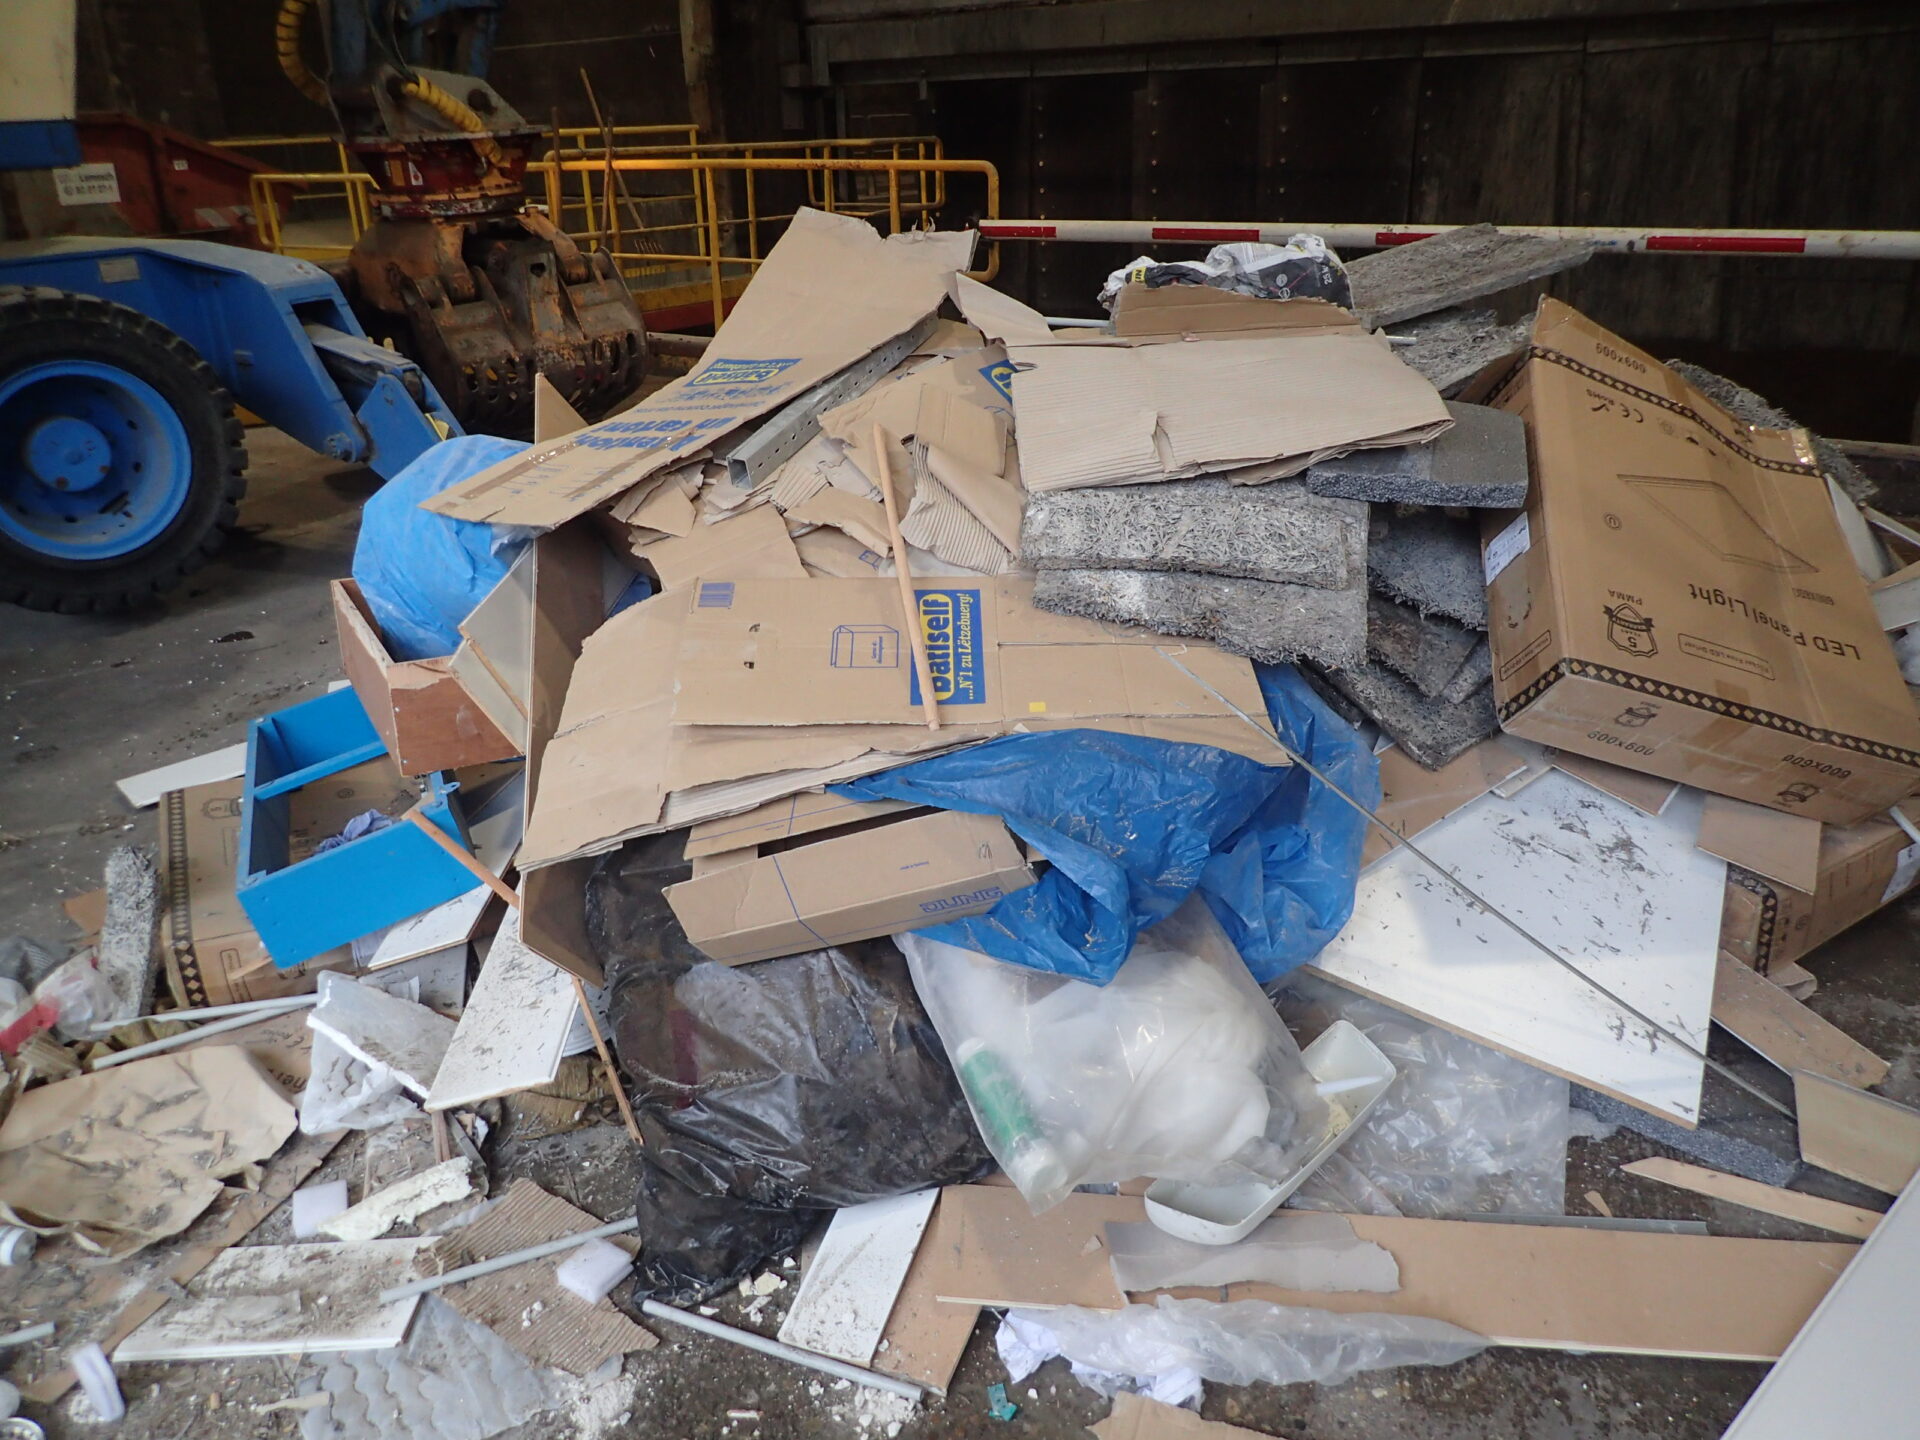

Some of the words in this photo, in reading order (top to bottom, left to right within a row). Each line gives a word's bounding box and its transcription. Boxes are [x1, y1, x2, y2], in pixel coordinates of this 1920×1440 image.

[1322, 273, 1333, 285] 25
[1595, 343, 1647, 374] 600x600
[695, 417, 736, 429] un
[1608, 589, 1642, 605] PMMA
[1689, 583, 1748, 618] Light
[956, 593, 974, 652] Lëtzebuerg!
[1754, 608, 1807, 646] Panel
[1628, 637, 1637, 648] 5
[1813, 636, 1861, 660] LED
[961, 657, 972, 667] zu
[1587, 730, 1656, 756] 600x600
[1782, 754, 1852, 780] 600x600
[919, 886, 1005, 913] JUNG
